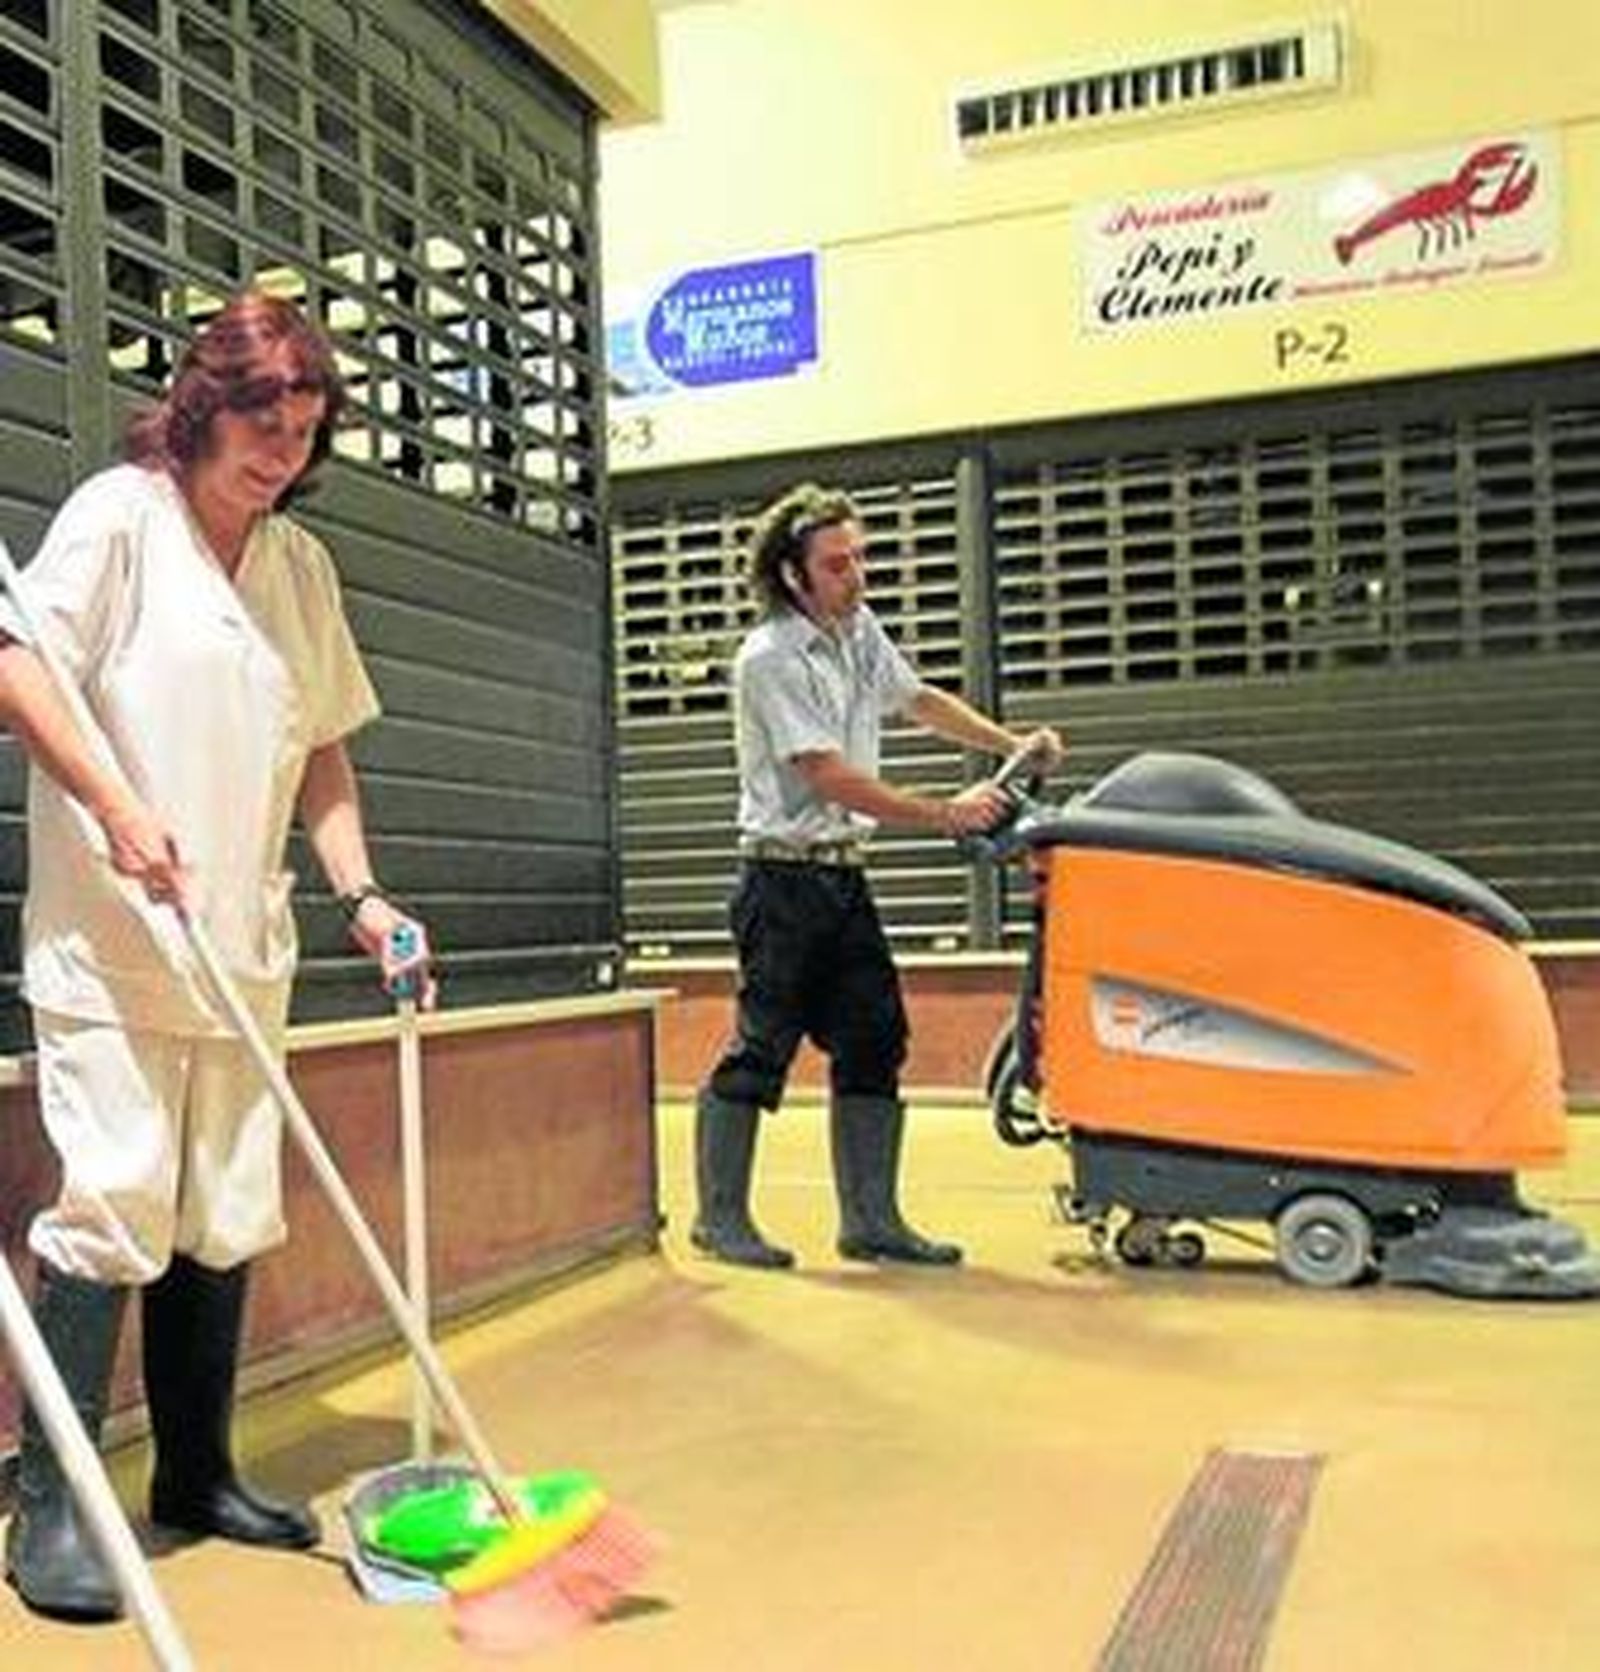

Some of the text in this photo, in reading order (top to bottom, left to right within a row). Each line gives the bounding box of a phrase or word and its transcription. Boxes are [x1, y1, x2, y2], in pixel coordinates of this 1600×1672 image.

[1117, 233, 1222, 284] Pepi
[1100, 275, 1284, 322] Clemente
[1275, 325, 1350, 369] P-2
